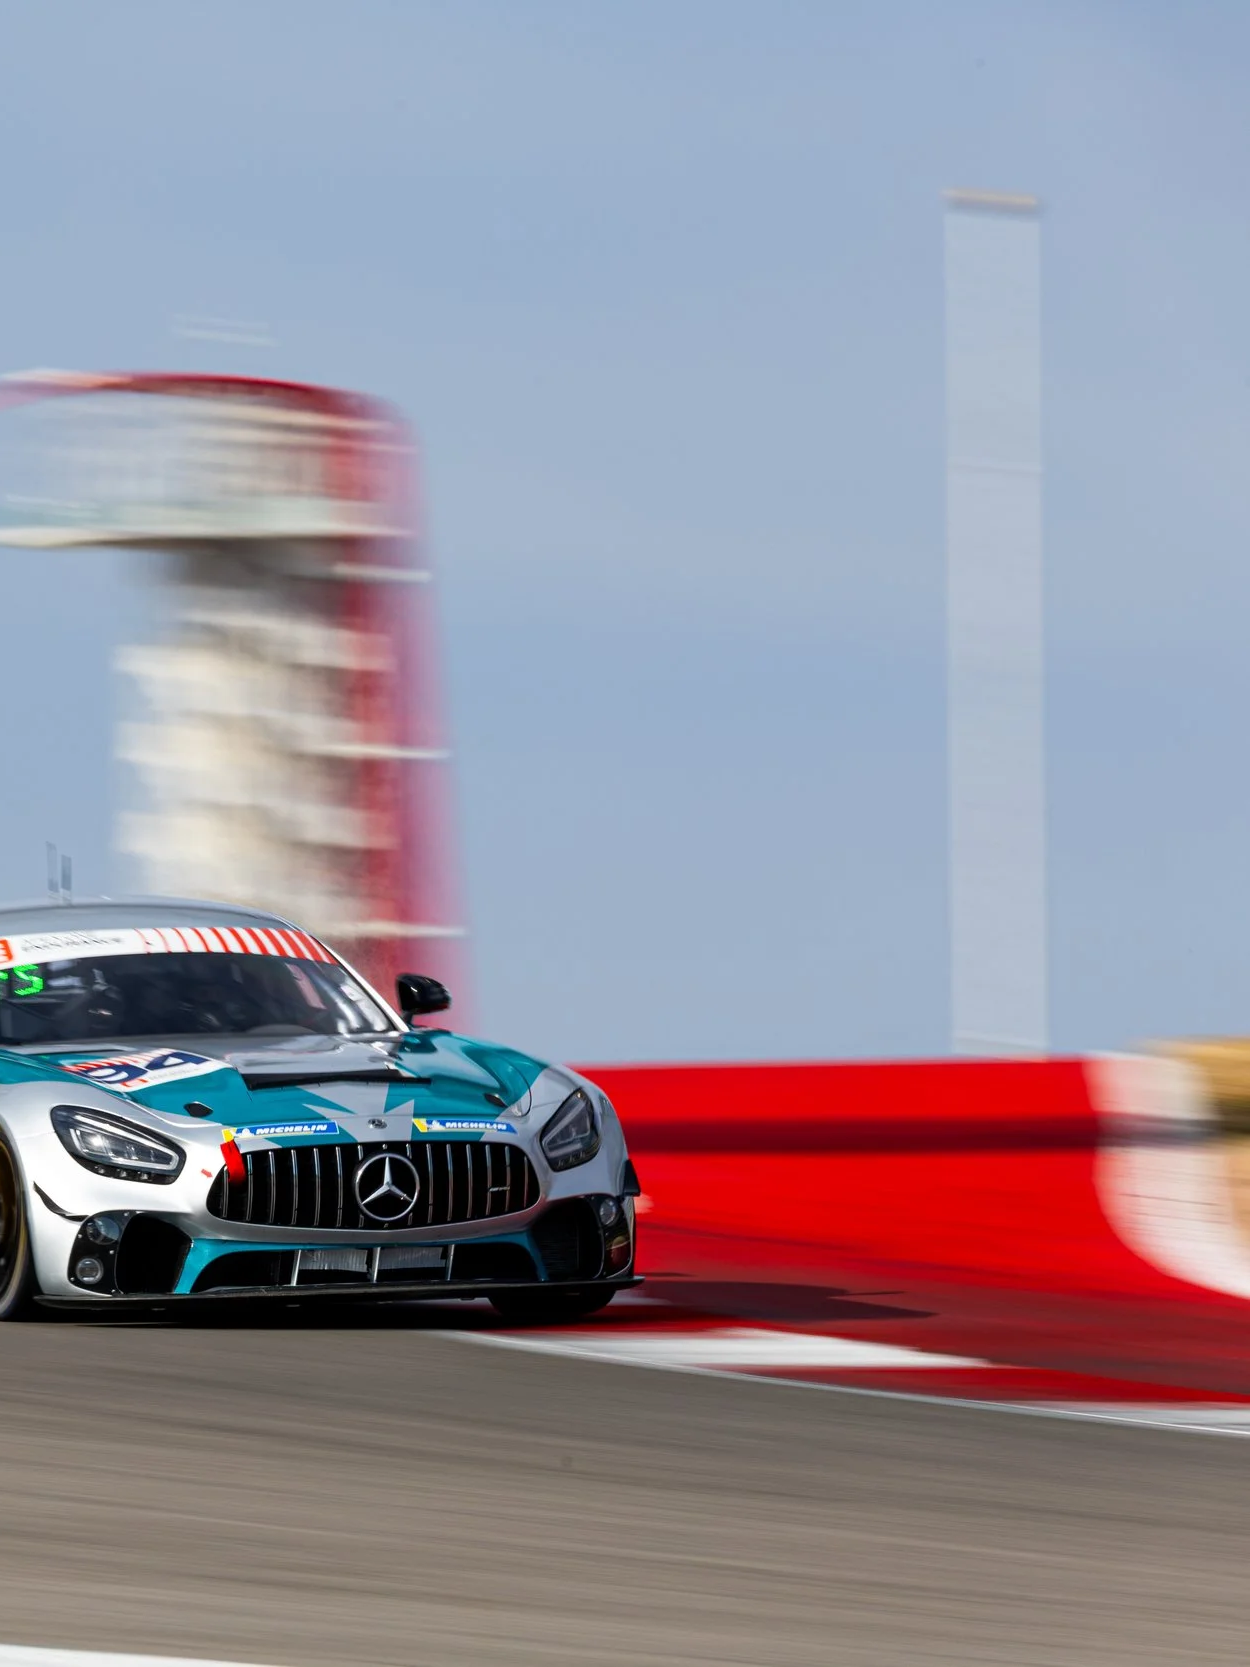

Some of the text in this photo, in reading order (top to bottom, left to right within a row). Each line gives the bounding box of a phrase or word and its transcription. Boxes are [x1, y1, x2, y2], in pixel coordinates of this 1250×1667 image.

[75, 1051, 211, 1084] 94
[256, 1123, 328, 1136] MICHELIN
[445, 1121, 508, 1131] MICHELIN
